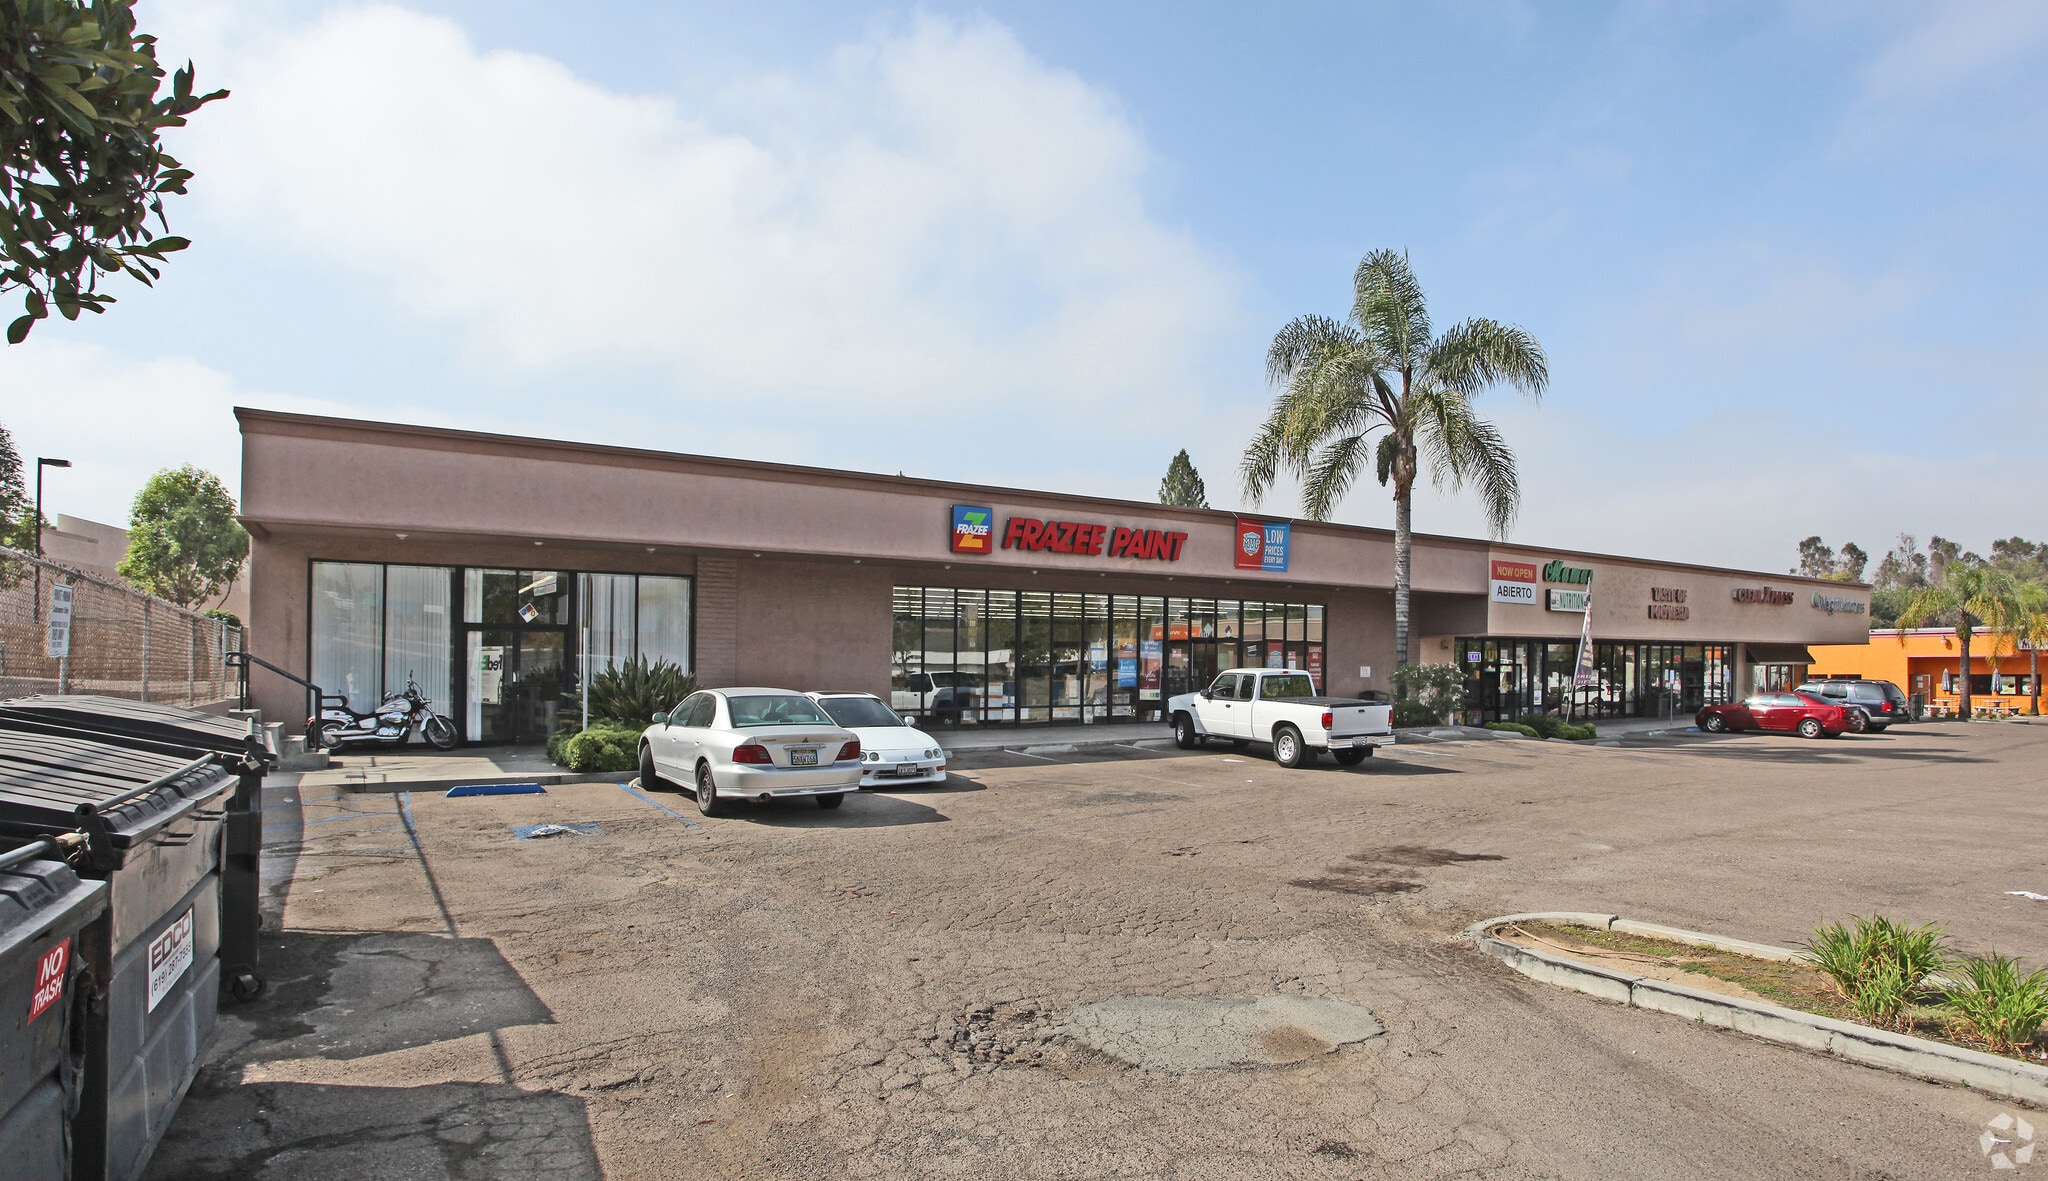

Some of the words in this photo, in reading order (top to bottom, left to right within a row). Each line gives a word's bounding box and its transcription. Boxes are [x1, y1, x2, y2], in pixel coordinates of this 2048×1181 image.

[956, 523, 989, 536] FRAZEE
[1265, 529, 1284, 544] LOW
[1004, 517, 1107, 555] FRAZEE
[1111, 527, 1188, 561] PAINT
[1264, 545, 1284, 556] PRICES
[1263, 555, 1275, 563] EVERY
[1496, 565, 1513, 577] NOW
[1514, 568, 1533, 579] OPEN
[1497, 584, 1532, 599] ABIERTO
[152, 911, 190, 972] EDCO
[40, 947, 64, 986] NO
[151, 968, 167, 997] (619)
[33, 973, 64, 1015] TRASH
